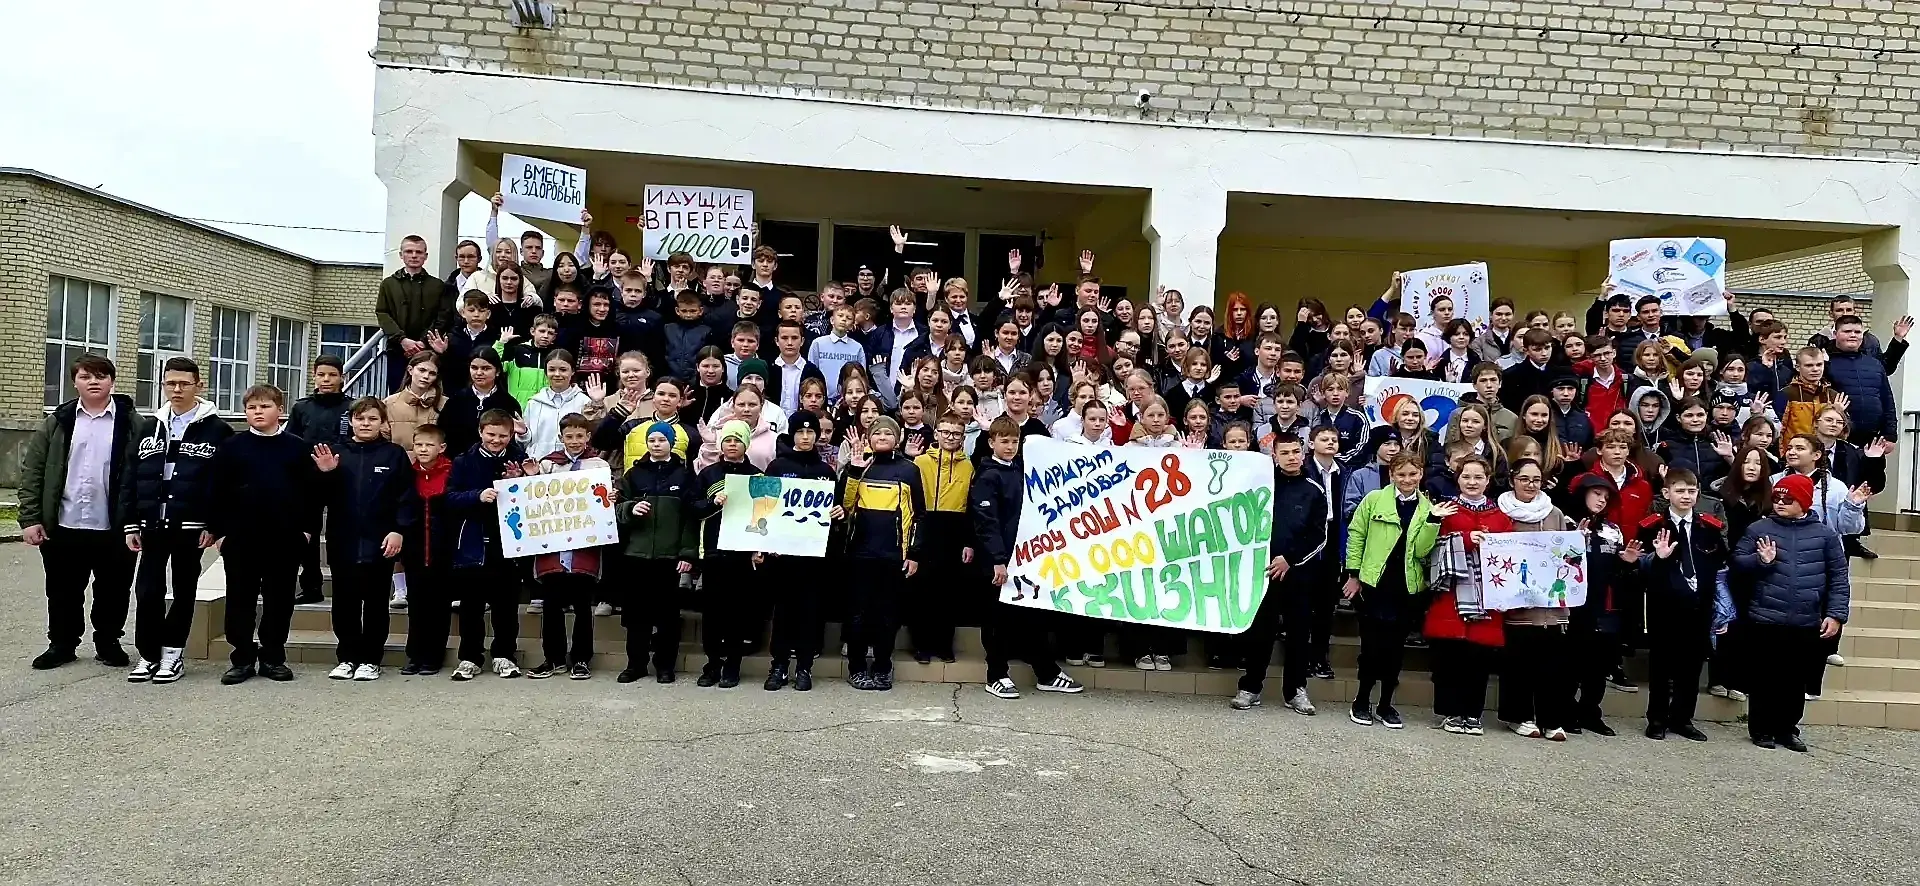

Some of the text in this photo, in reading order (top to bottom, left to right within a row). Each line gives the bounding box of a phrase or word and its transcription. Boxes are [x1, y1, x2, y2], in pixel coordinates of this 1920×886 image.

[523, 163, 578, 189] ВМЕСТЕ
[510, 177, 581, 206] К ЗДОРОВЬЮ
[647, 188, 744, 211] ИДУЩИЕ
[645, 209, 749, 230] ВПЕРЁД
[656, 232, 729, 260] 10000
[1427, 286, 1453, 299] 10000
[524, 496, 589, 519] ШАГОВ
[1014, 529, 1067, 567] МБОУ
[1069, 497, 1122, 540] СОШ
[1134, 453, 1192, 514] 28
[527, 514, 596, 537] ВПЕРЕД
[1154, 486, 1272, 563] ШАГОВ
[1076, 546, 1268, 629] ЖИЗНИ
